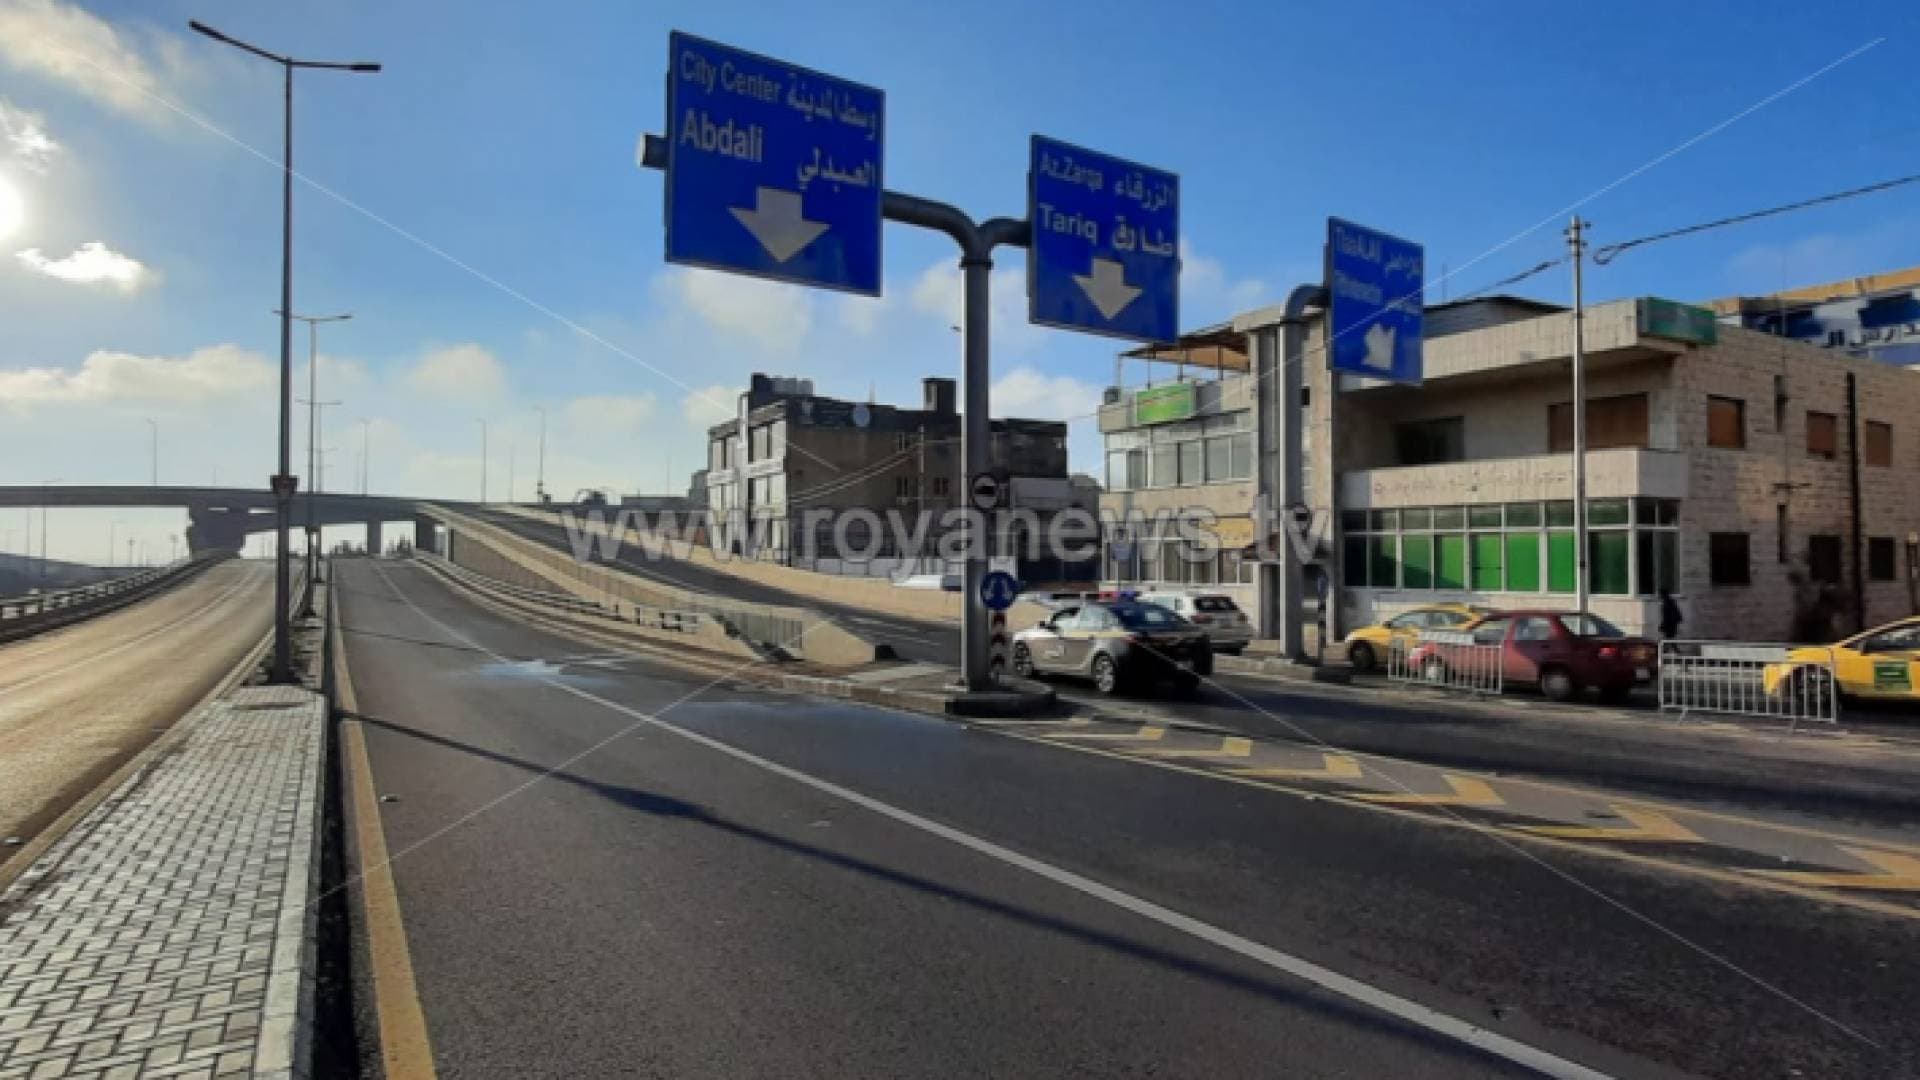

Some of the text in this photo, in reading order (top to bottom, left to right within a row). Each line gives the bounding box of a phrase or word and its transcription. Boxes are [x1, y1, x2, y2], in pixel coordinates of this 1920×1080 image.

[681, 50, 782, 103] City Center
[682, 108, 763, 162] Abdali
[1039, 202, 1097, 246] Tariq
[1111, 214, 1173, 255] طارق
